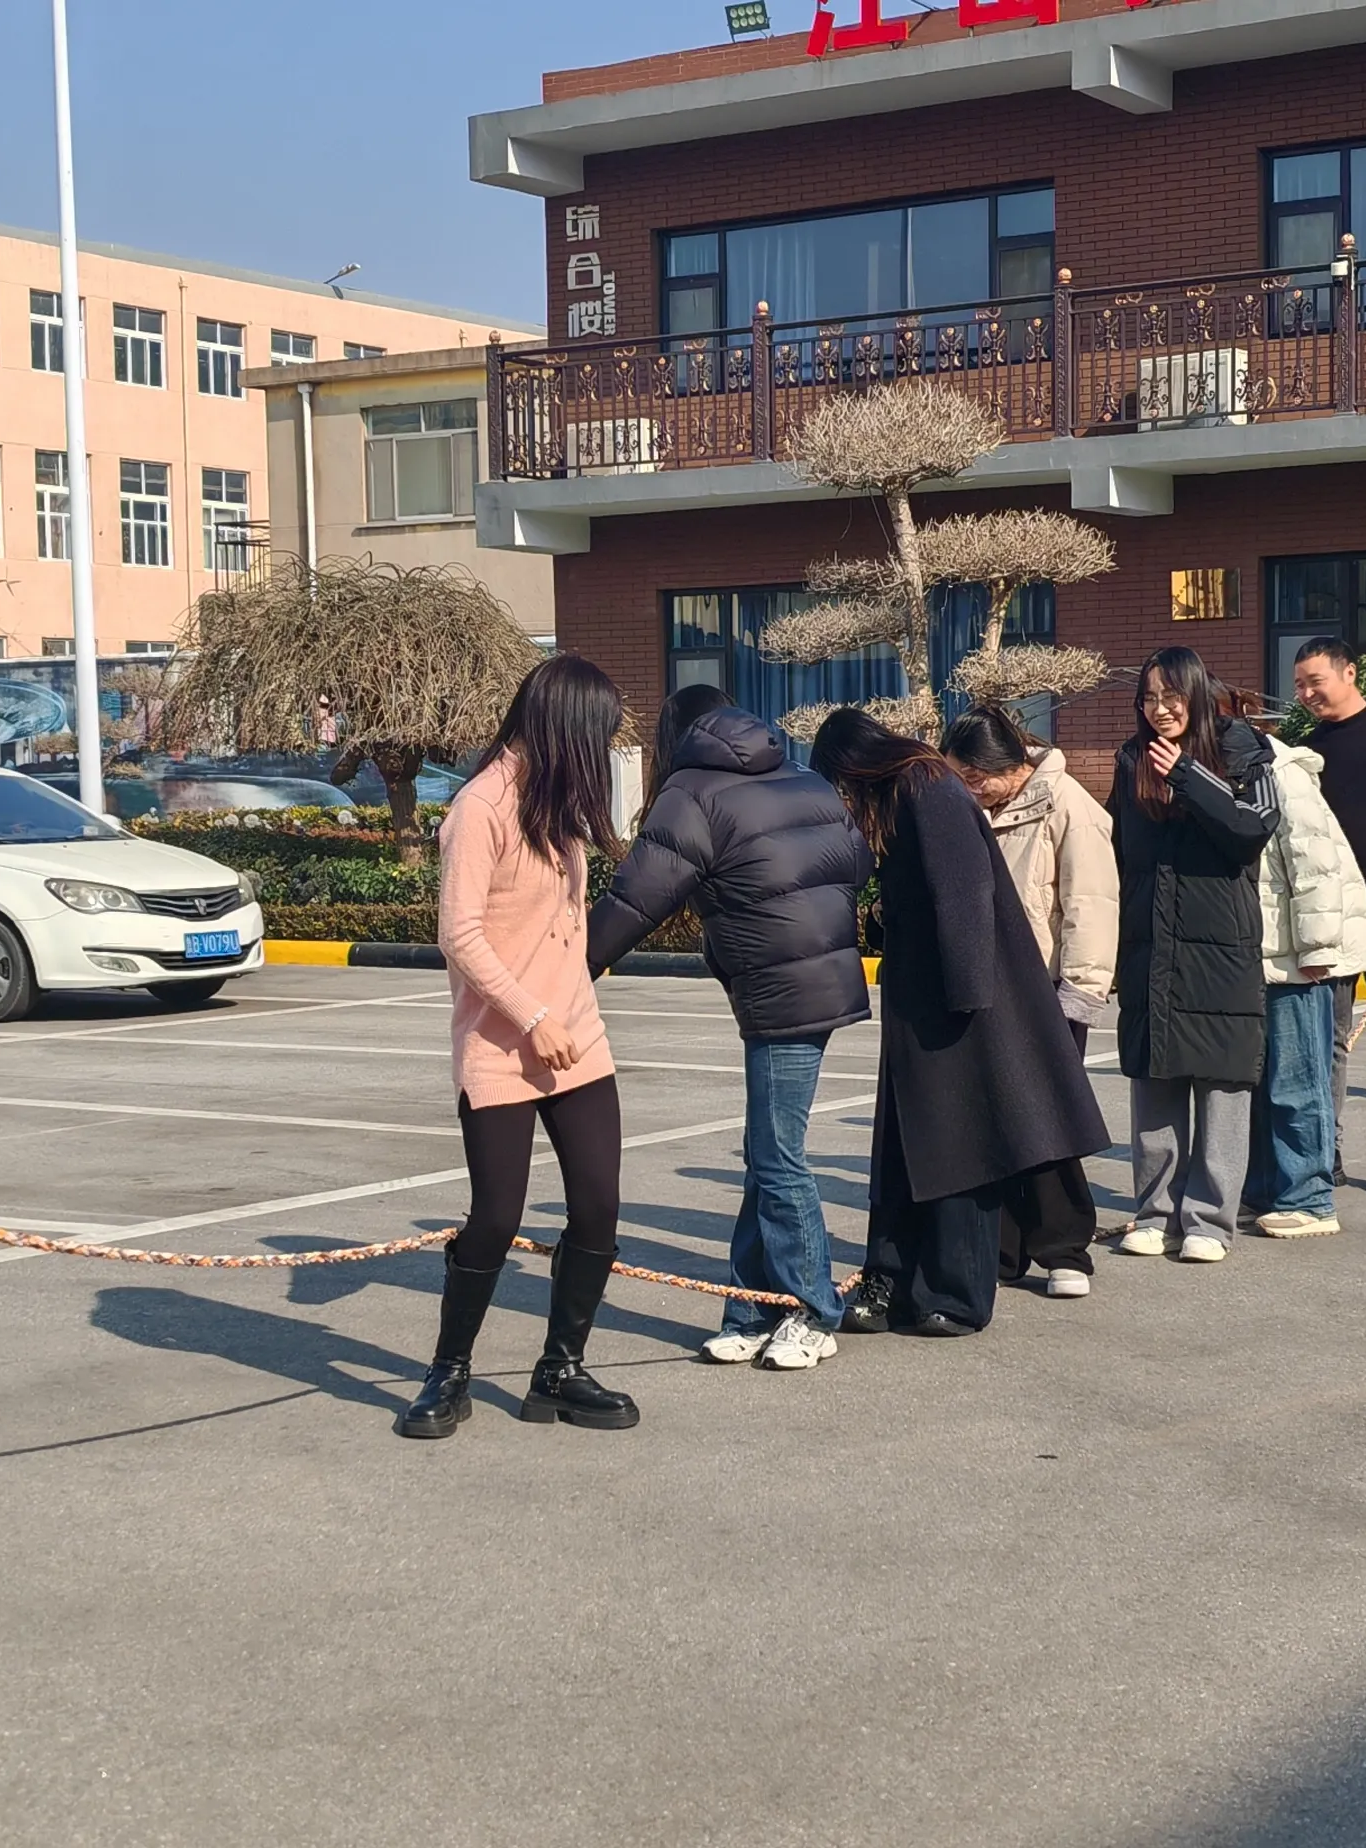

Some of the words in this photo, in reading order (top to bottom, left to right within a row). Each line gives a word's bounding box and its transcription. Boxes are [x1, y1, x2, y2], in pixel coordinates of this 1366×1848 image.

[566, 204, 602, 338] 综合楼
[602, 270, 616, 336] TOWER
